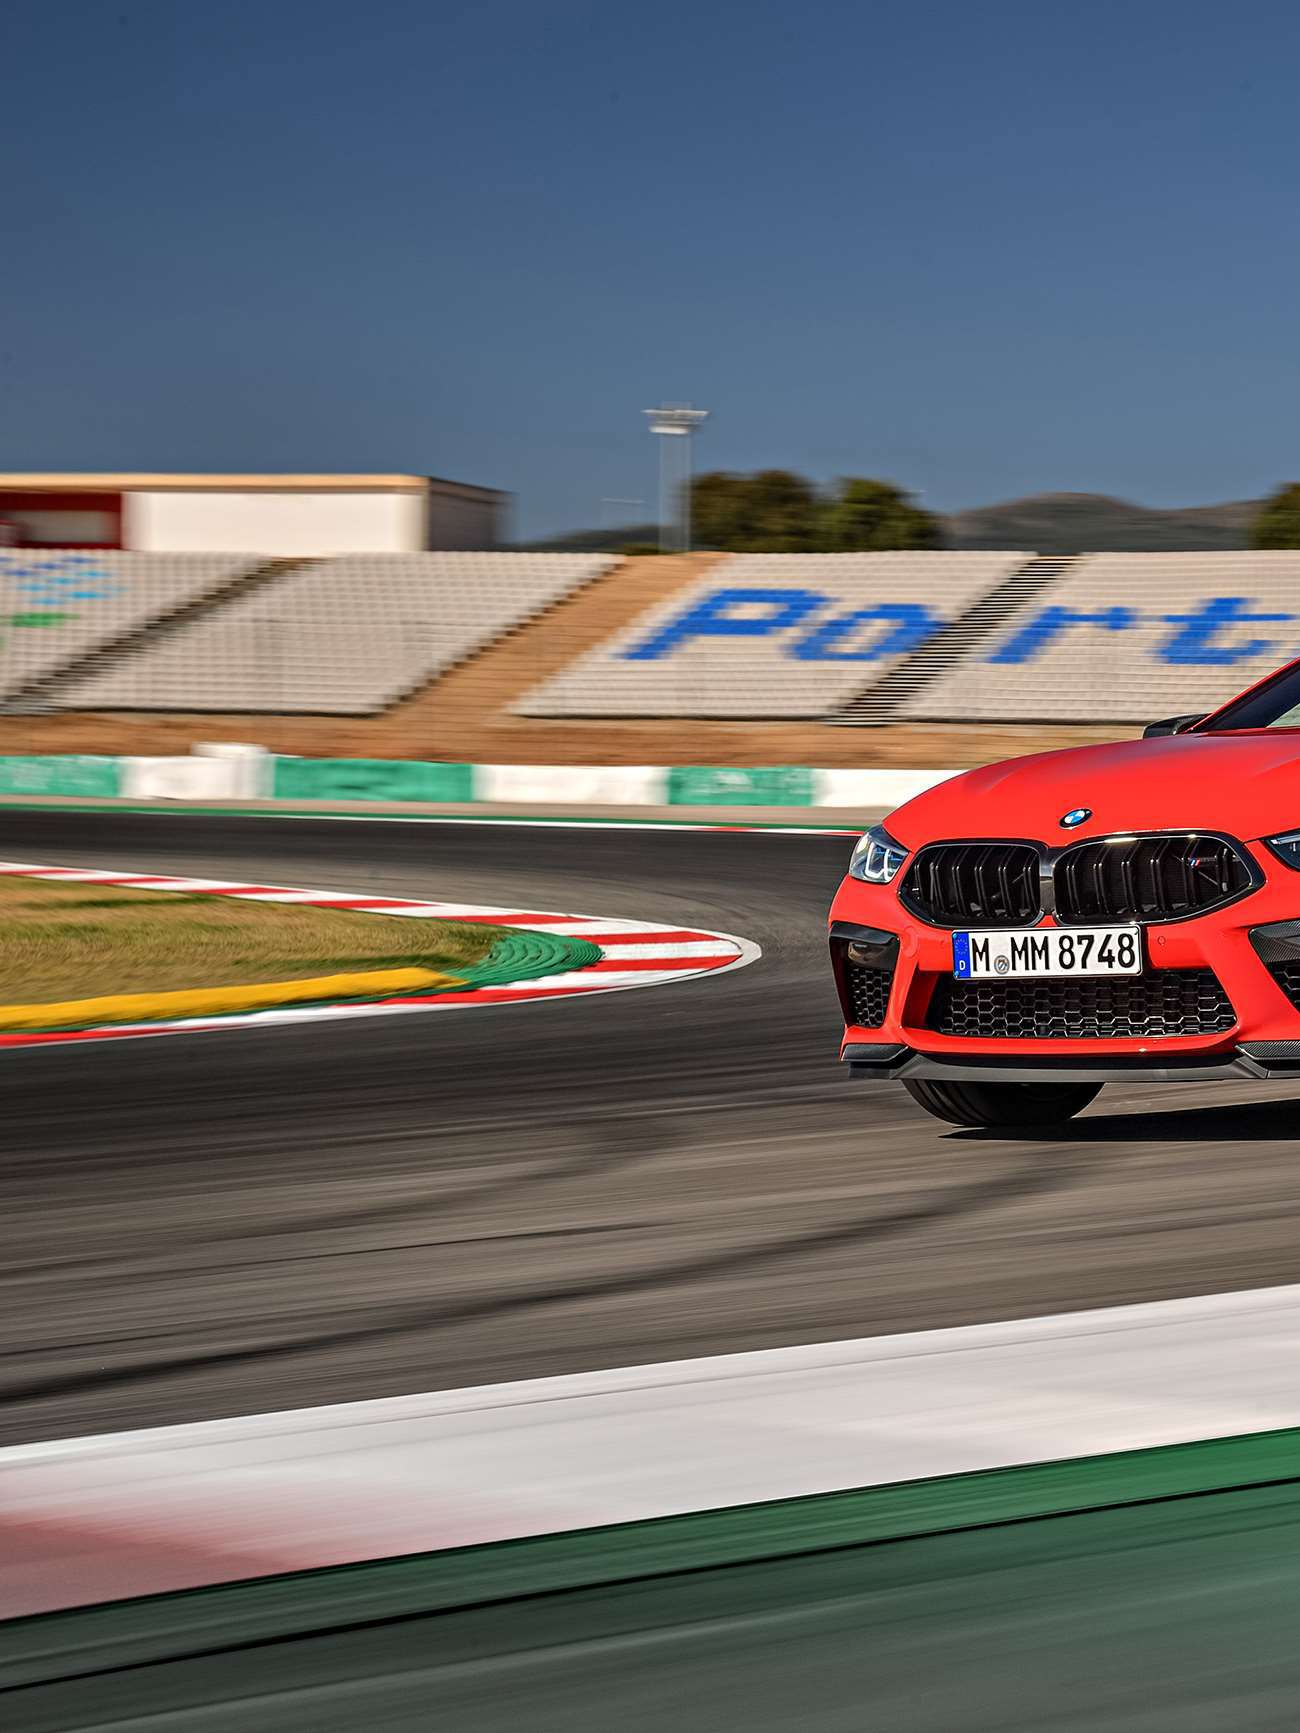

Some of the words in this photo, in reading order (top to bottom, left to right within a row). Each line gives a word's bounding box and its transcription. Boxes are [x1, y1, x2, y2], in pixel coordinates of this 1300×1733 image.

[971, 937, 990, 972] M
[1010, 936, 1050, 971] MM
[1058, 933, 1136, 969] 8748
[959, 960, 966, 970] D
